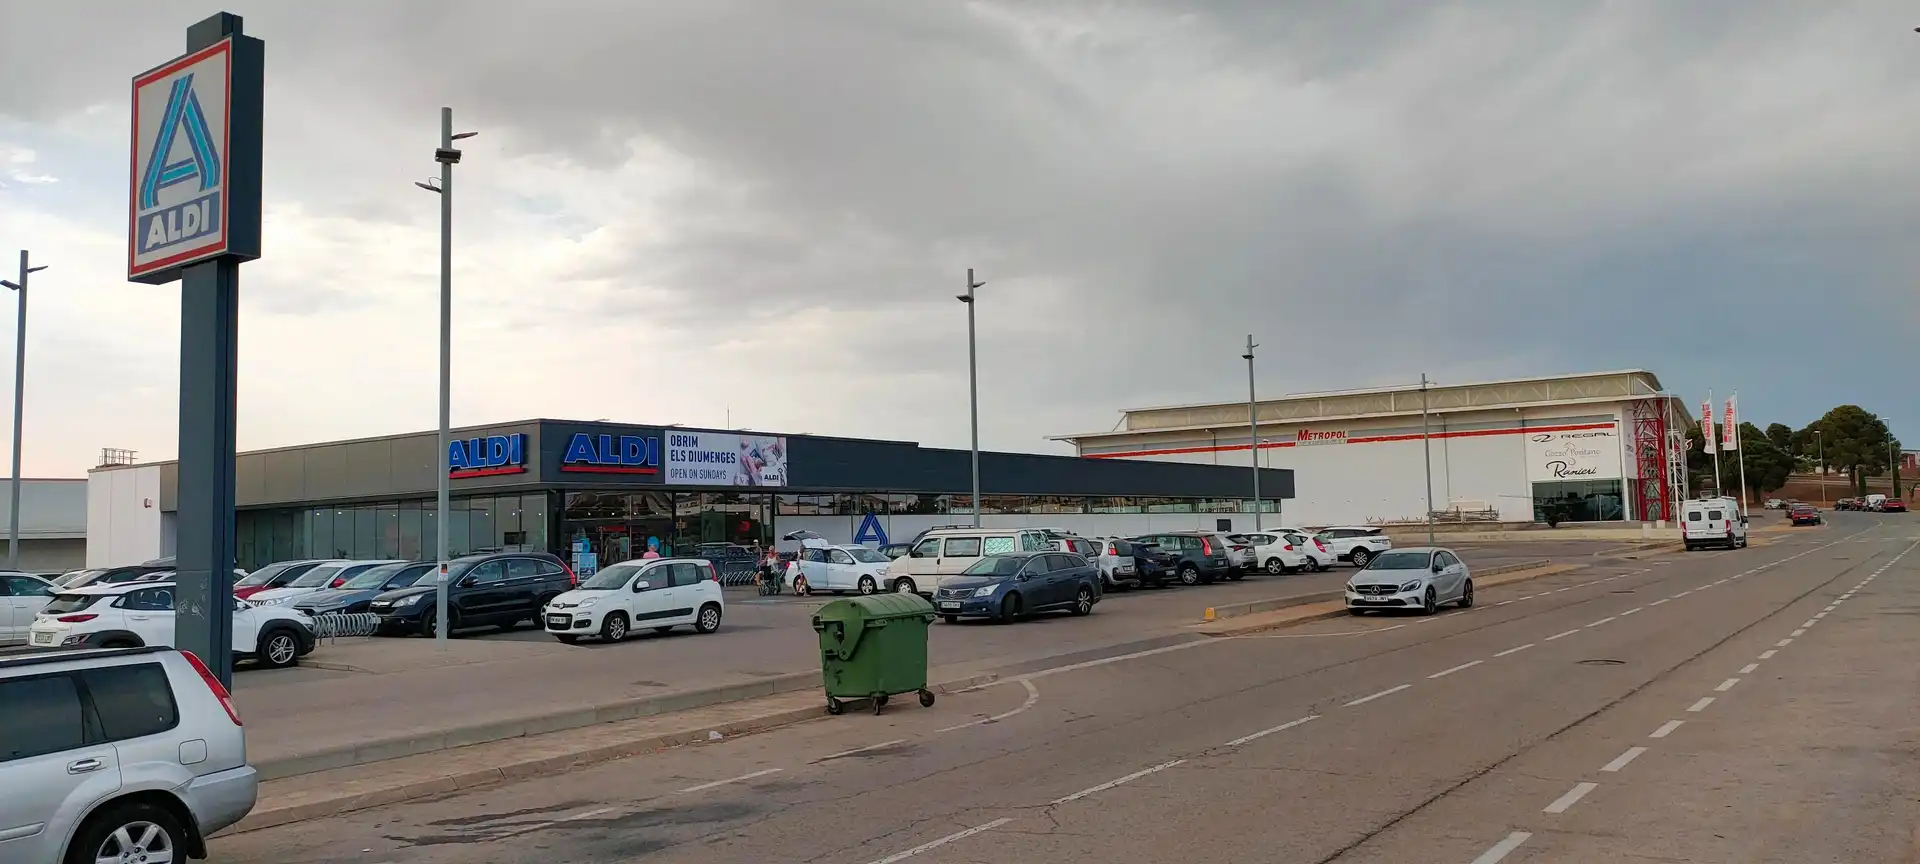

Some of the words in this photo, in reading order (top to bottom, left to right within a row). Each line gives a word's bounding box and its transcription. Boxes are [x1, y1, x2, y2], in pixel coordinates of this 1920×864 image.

[145, 199, 209, 250] ALDI
[670, 434, 699, 448] OBRIM
[1297, 429, 1347, 441] METROPOL
[1560, 431, 1616, 439] REGAL
[449, 432, 525, 470] ALDI
[564, 432, 659, 466] ALDI
[1570, 448, 1601, 456] Positano
[670, 449, 687, 462] ELS
[688, 450, 736, 464] DIUMENGES
[670, 468, 688, 479] OPEN
[689, 468, 698, 479] ON
[699, 469, 727, 480] SUNDAYS
[1546, 460, 1597, 478] Ranieri
